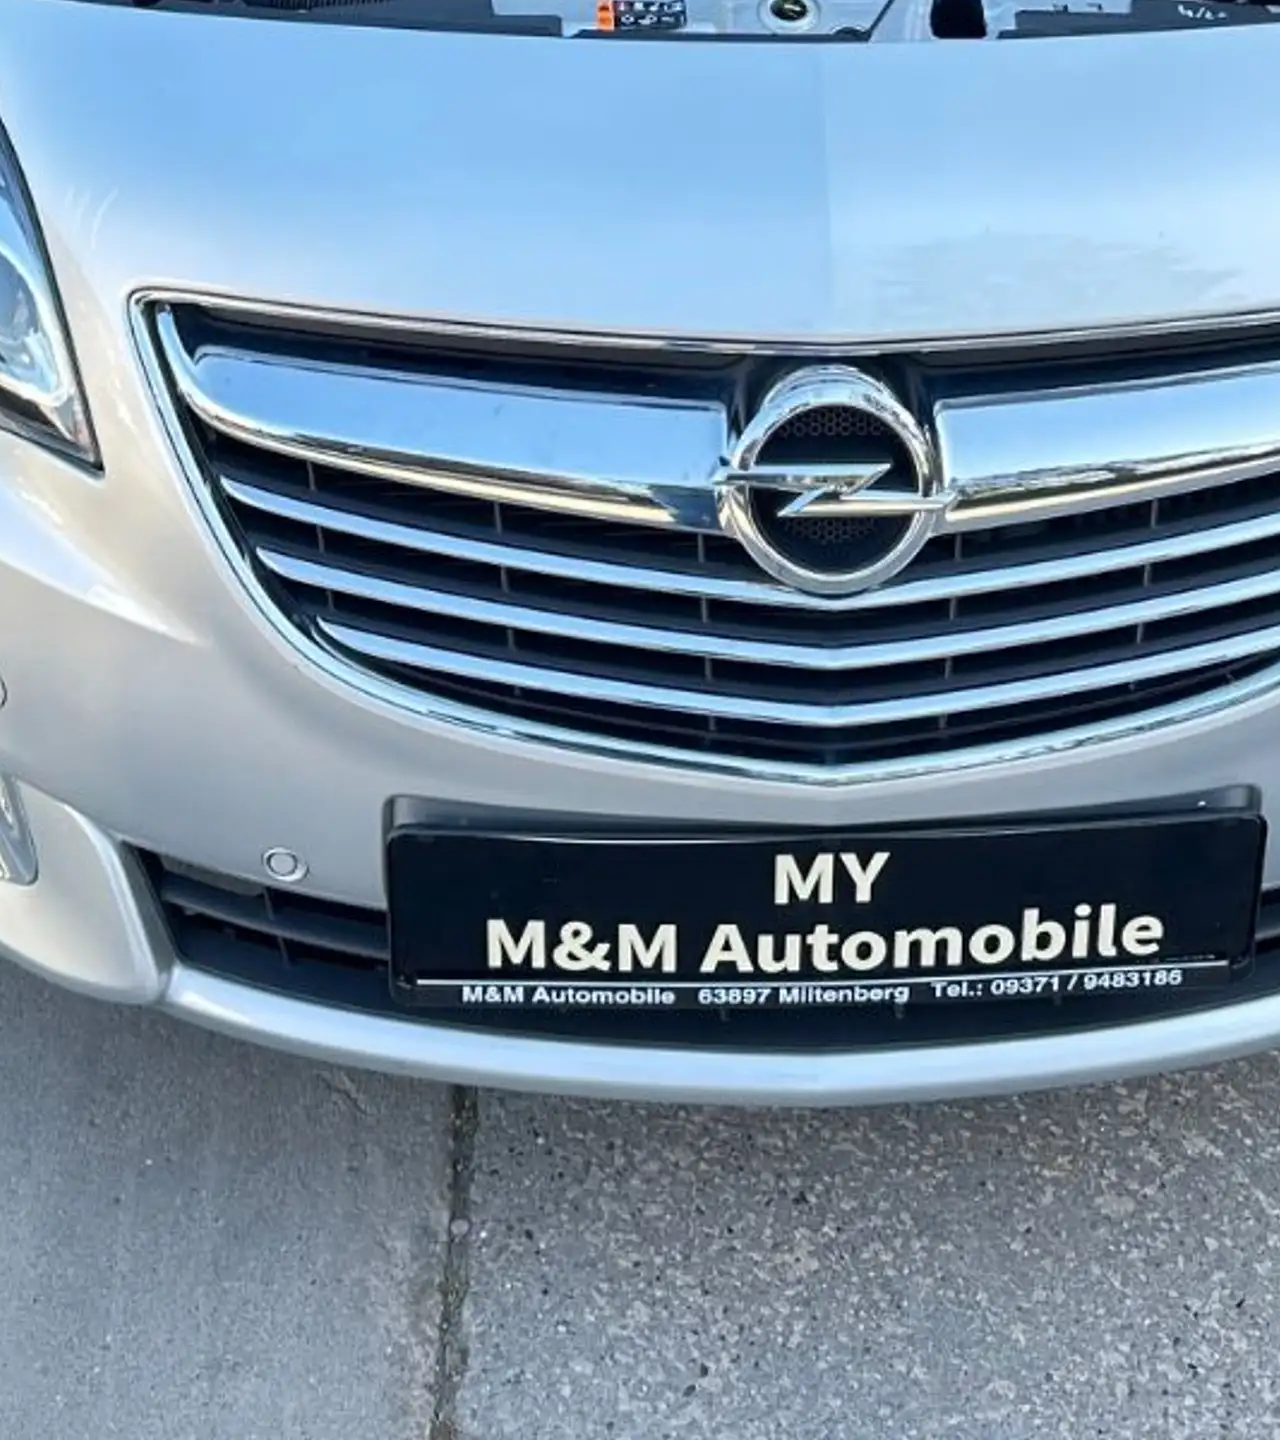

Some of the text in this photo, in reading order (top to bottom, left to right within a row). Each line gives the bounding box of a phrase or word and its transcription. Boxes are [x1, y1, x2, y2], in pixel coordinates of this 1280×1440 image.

[775, 852, 891, 905] MY
[486, 903, 1164, 973] M&M Automobile
[462, 985, 525, 1003] M&M
[531, 985, 676, 1005] Automobile
[697, 988, 772, 1005] 63897
[779, 986, 910, 1004] Miltenberg
[930, 980, 983, 998] Tel.:
[990, 974, 1060, 996] 09371
[1083, 969, 1183, 990] 9483186
